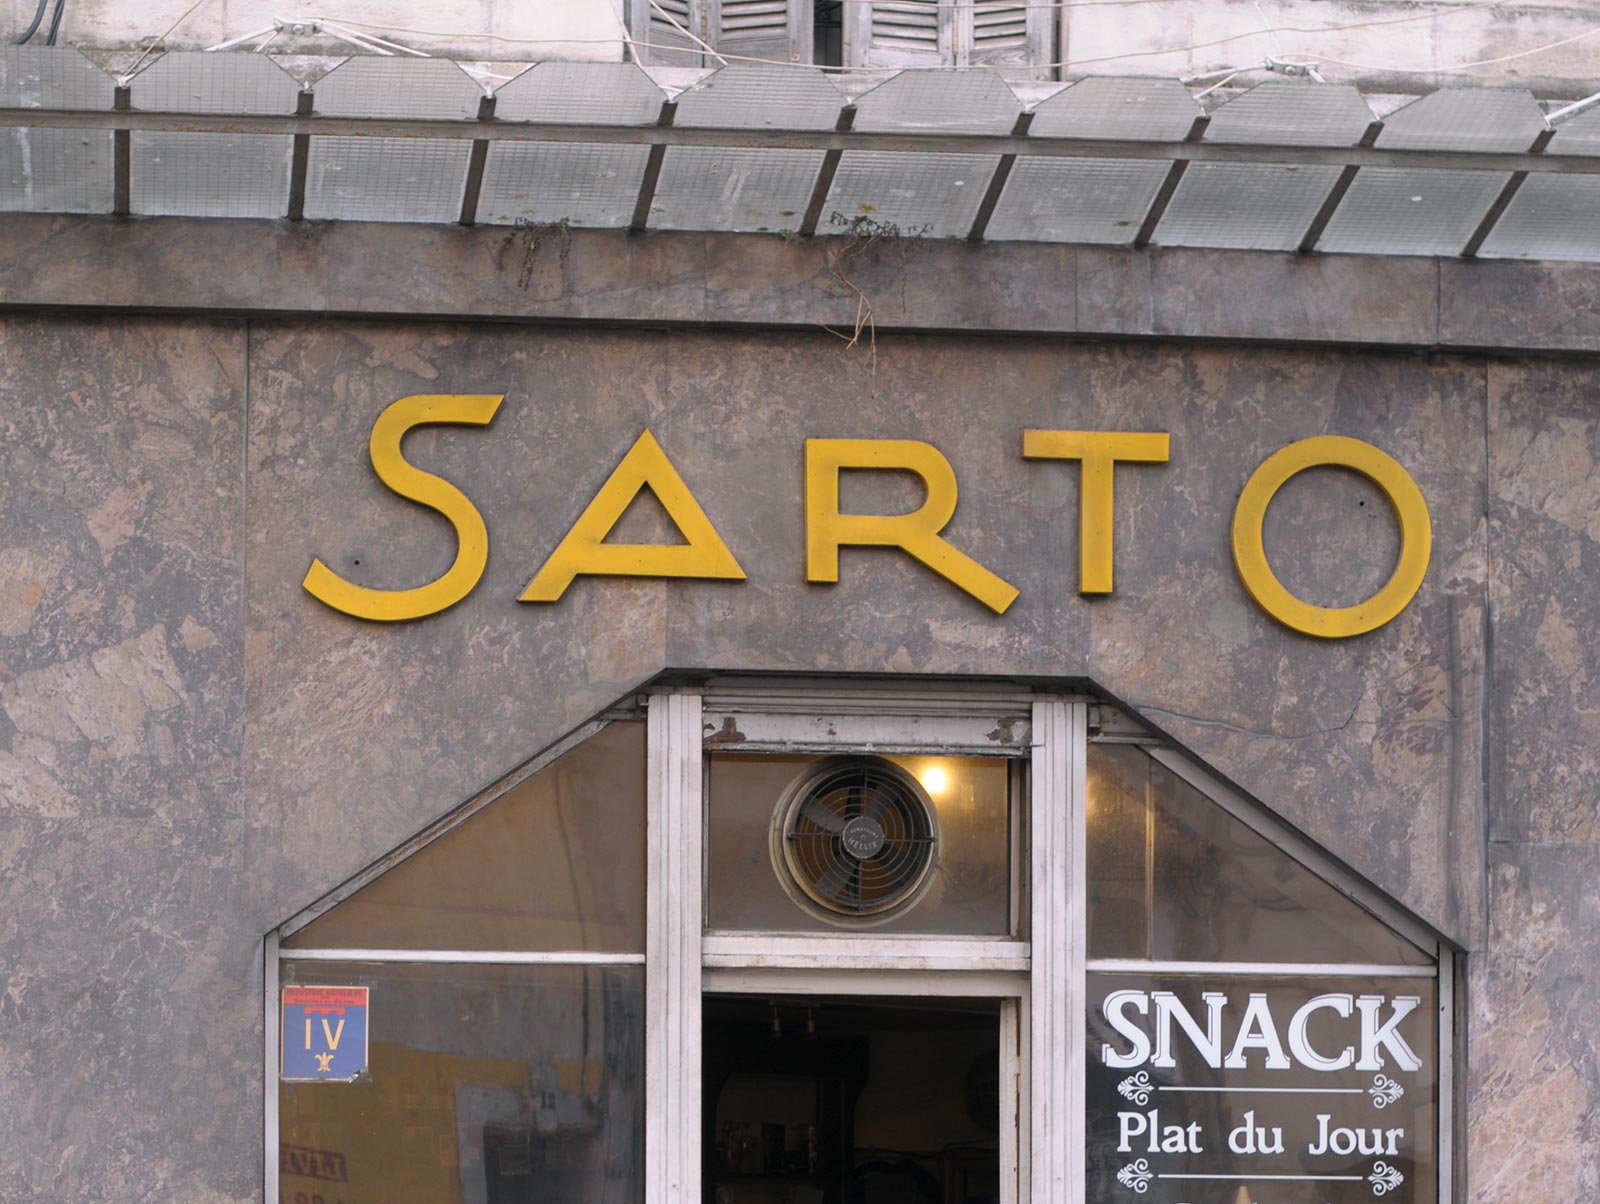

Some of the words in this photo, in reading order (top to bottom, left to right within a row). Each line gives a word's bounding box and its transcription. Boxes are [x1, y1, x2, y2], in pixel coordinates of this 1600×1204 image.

[303, 394, 1432, 639] SARTO
[305, 1018, 346, 1051] IV
[1101, 989, 1422, 1071] SNACK
[1117, 1109, 1203, 1153] Plat
[1228, 1110, 1284, 1154] du
[1308, 1114, 1404, 1155] Jour
